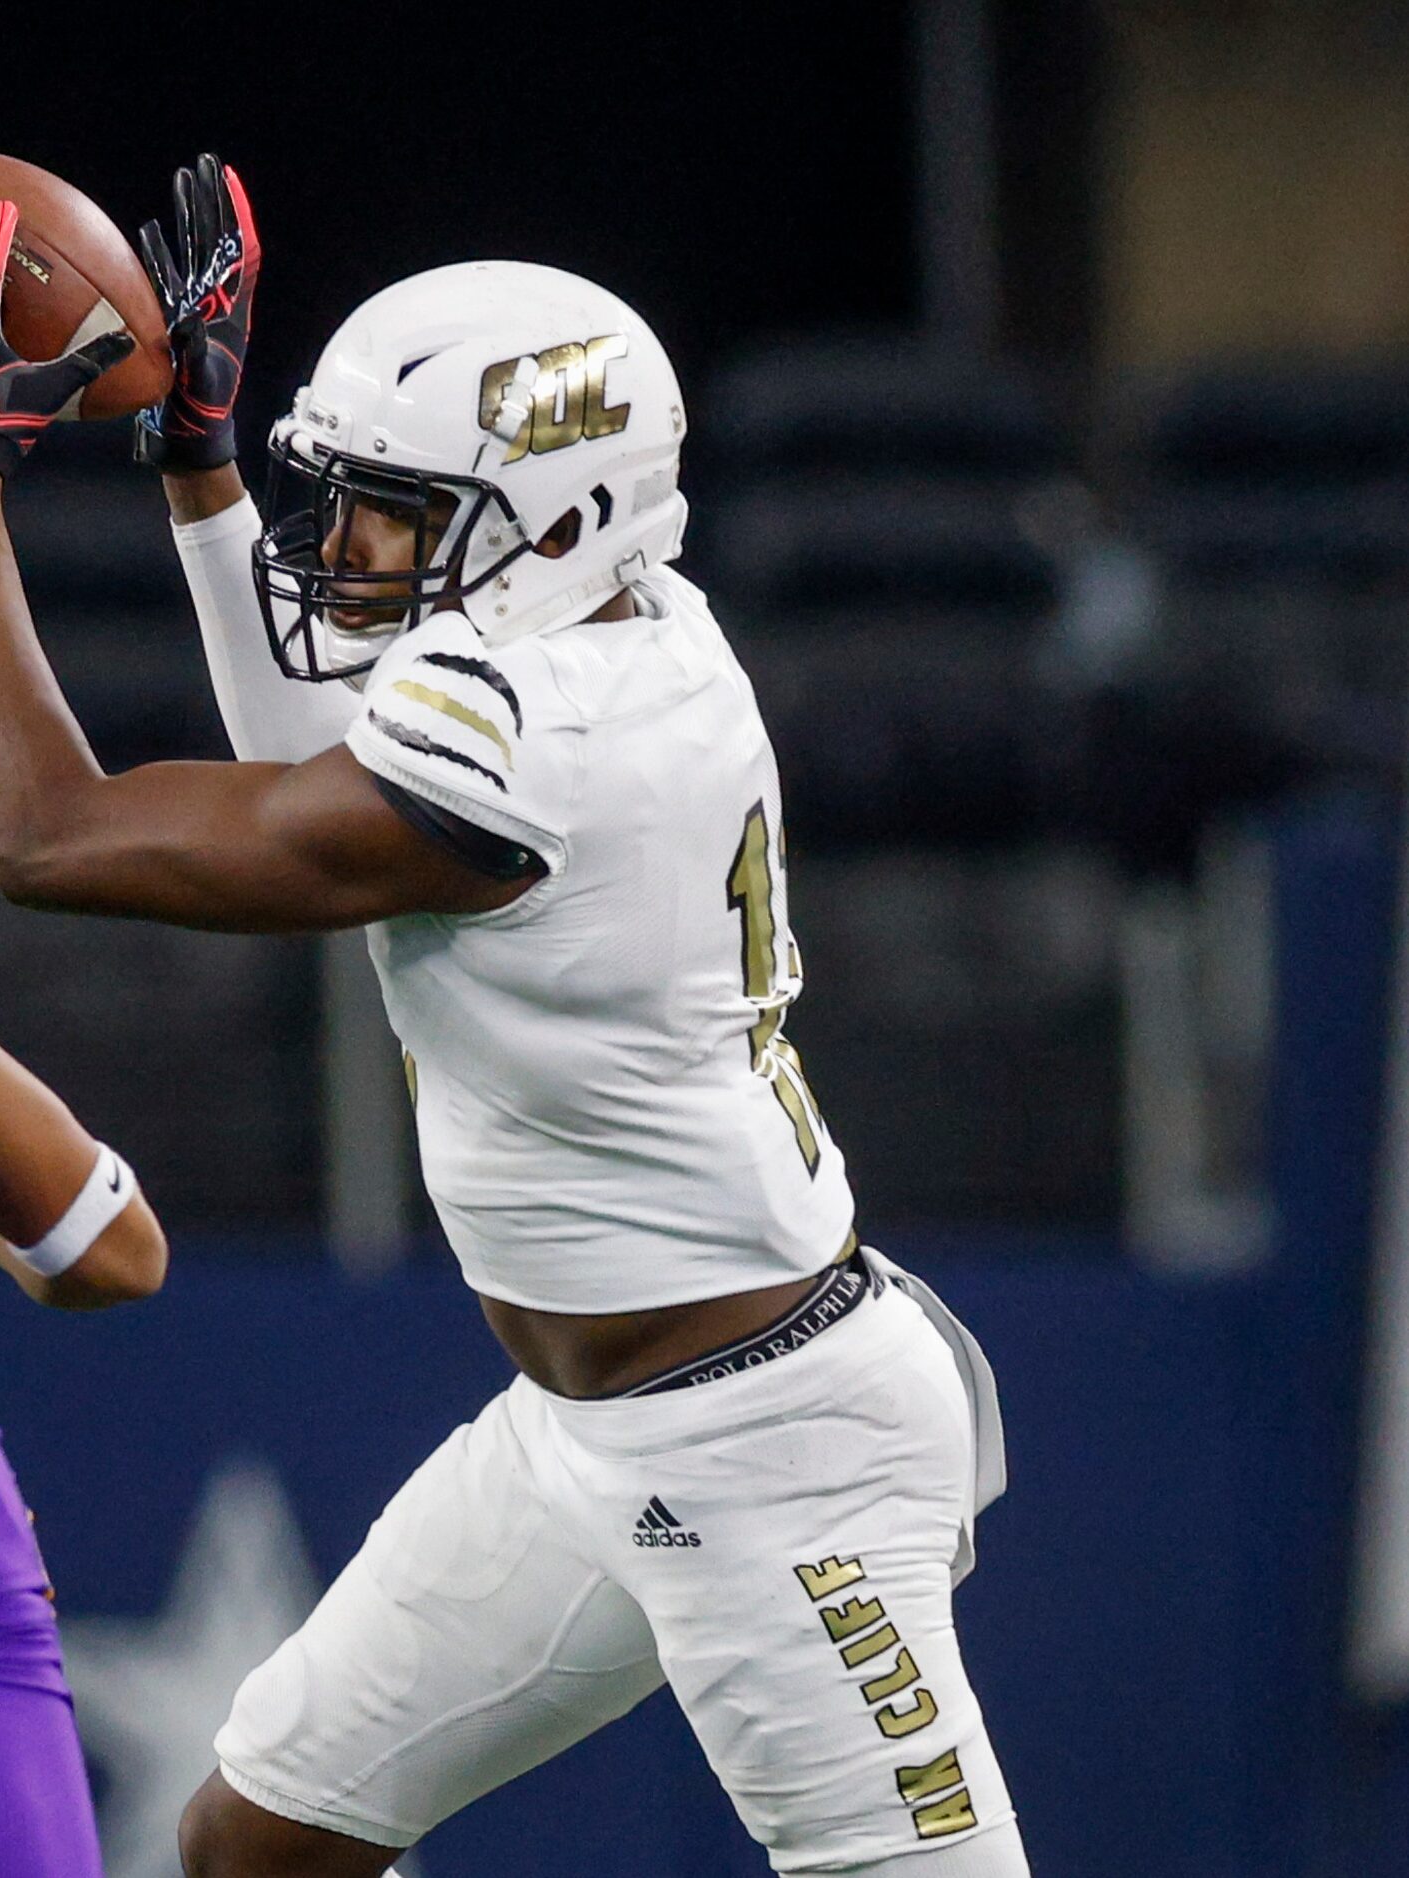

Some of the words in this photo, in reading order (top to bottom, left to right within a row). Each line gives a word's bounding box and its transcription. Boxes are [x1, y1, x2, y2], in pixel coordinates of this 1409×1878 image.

[478, 333, 631, 465] SOC
[726, 796, 824, 1183] 1
[689, 1350, 767, 1387] POLO
[766, 1294, 846, 1354] RALPH
[632, 1526, 702, 1548] adidas
[793, 1554, 939, 1740] CLIFF
